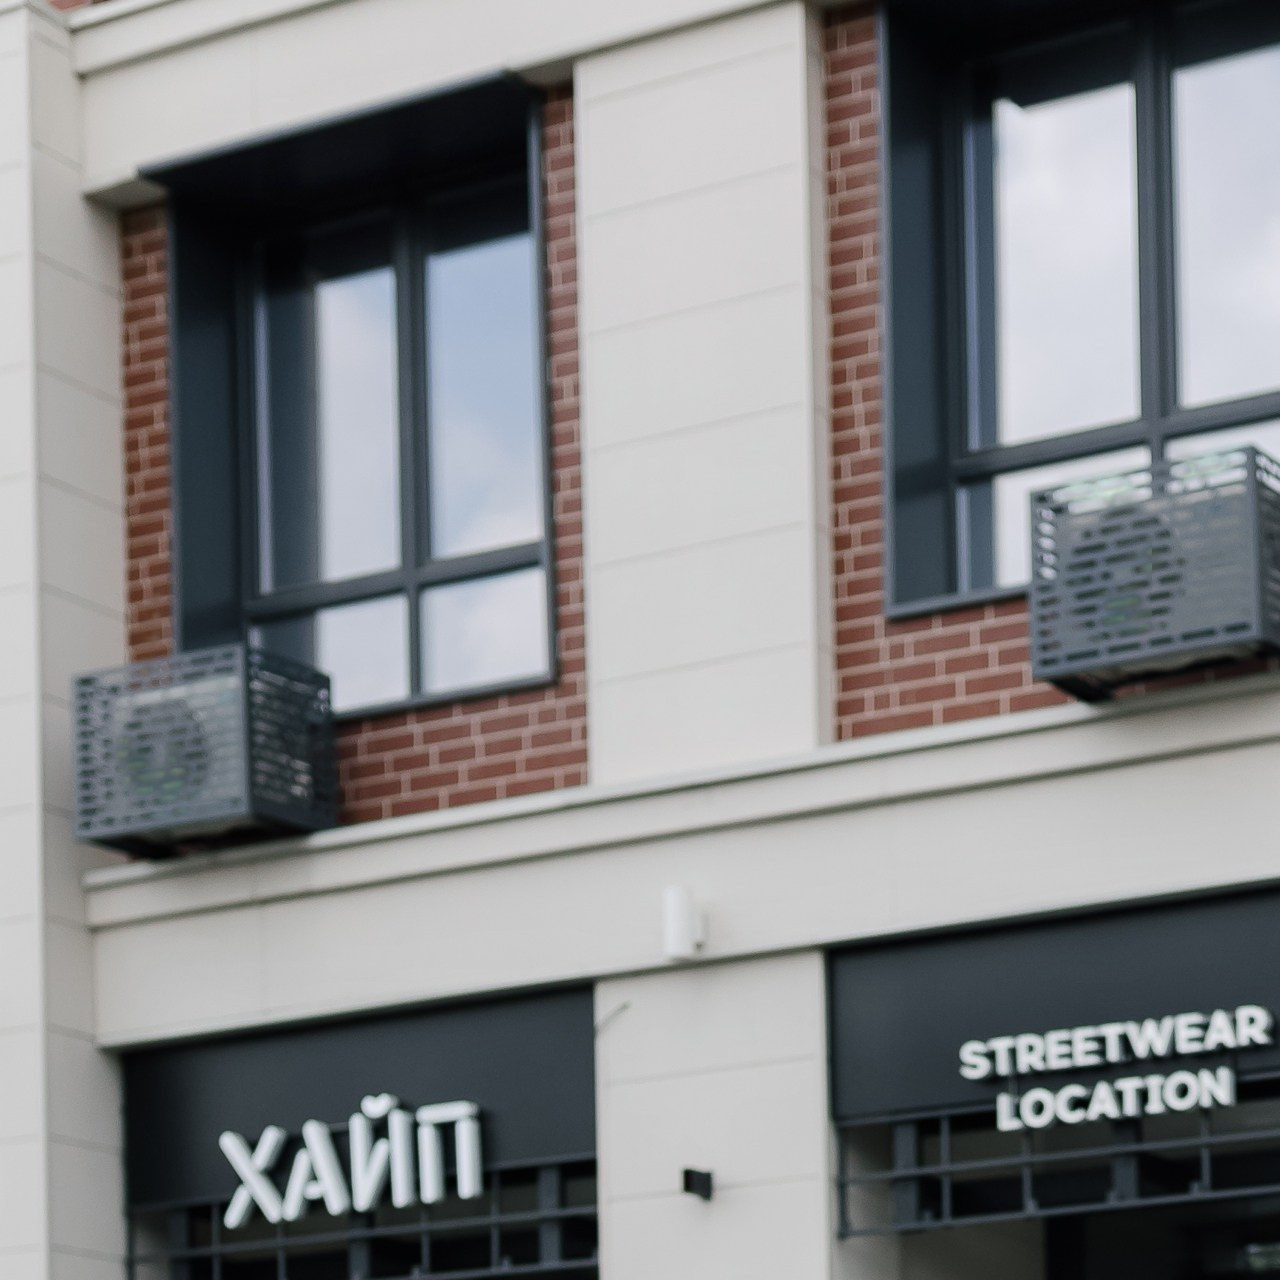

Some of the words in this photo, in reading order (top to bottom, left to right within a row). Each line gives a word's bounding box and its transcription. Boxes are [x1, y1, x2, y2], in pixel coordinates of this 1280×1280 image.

[959, 1004, 1274, 1080] STREETWEAR
[996, 1065, 1236, 1132] LOCATION
[218, 1092, 484, 1229] ХАЙП
